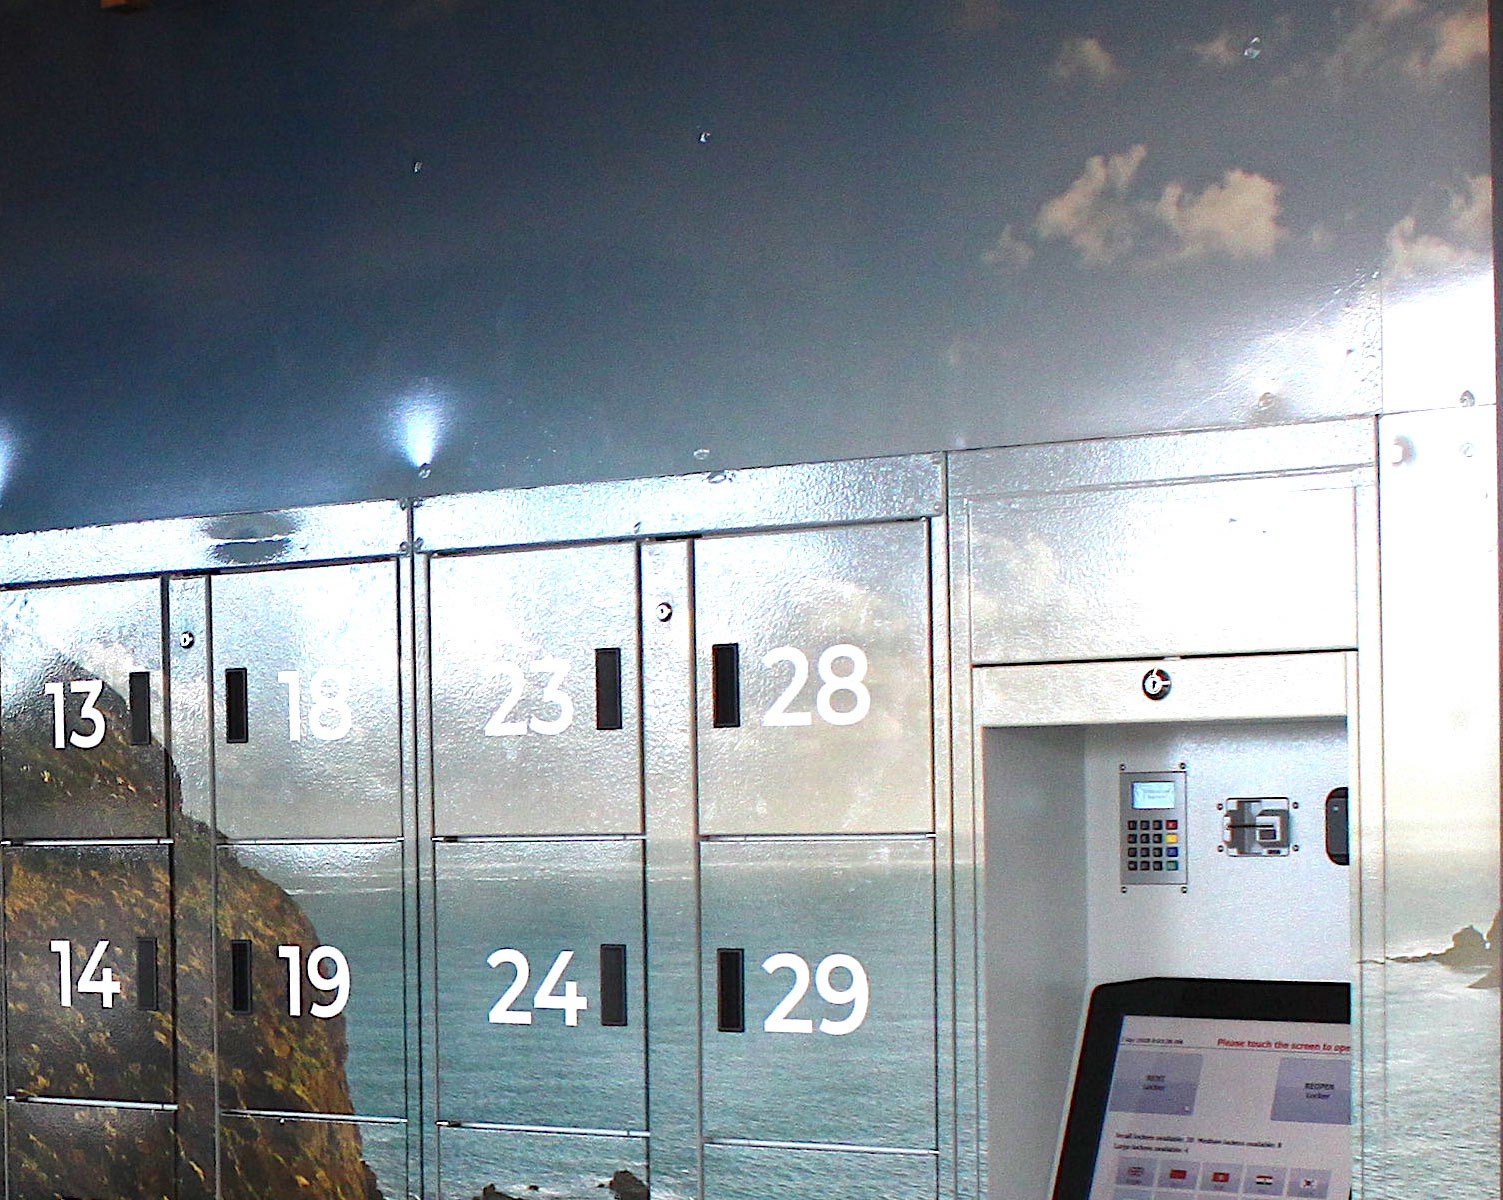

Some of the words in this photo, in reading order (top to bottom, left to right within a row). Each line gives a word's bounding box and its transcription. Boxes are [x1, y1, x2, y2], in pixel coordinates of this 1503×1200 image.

[45, 679, 107, 749] 13
[277, 669, 352, 742] 18
[484, 659, 574, 737] 23
[762, 642, 872, 728] 28
[49, 939, 121, 1008] 14
[277, 945, 351, 1019] 19
[487, 948, 588, 1027] 24
[762, 952, 870, 1036] 29
[1216, 1037, 1245, 1048] Please
[1247, 1039, 1272, 1049] touch
[1274, 1040, 1289, 1050] the
[1291, 1043, 1320, 1051] screen
[1322, 1042, 1333, 1051] to
